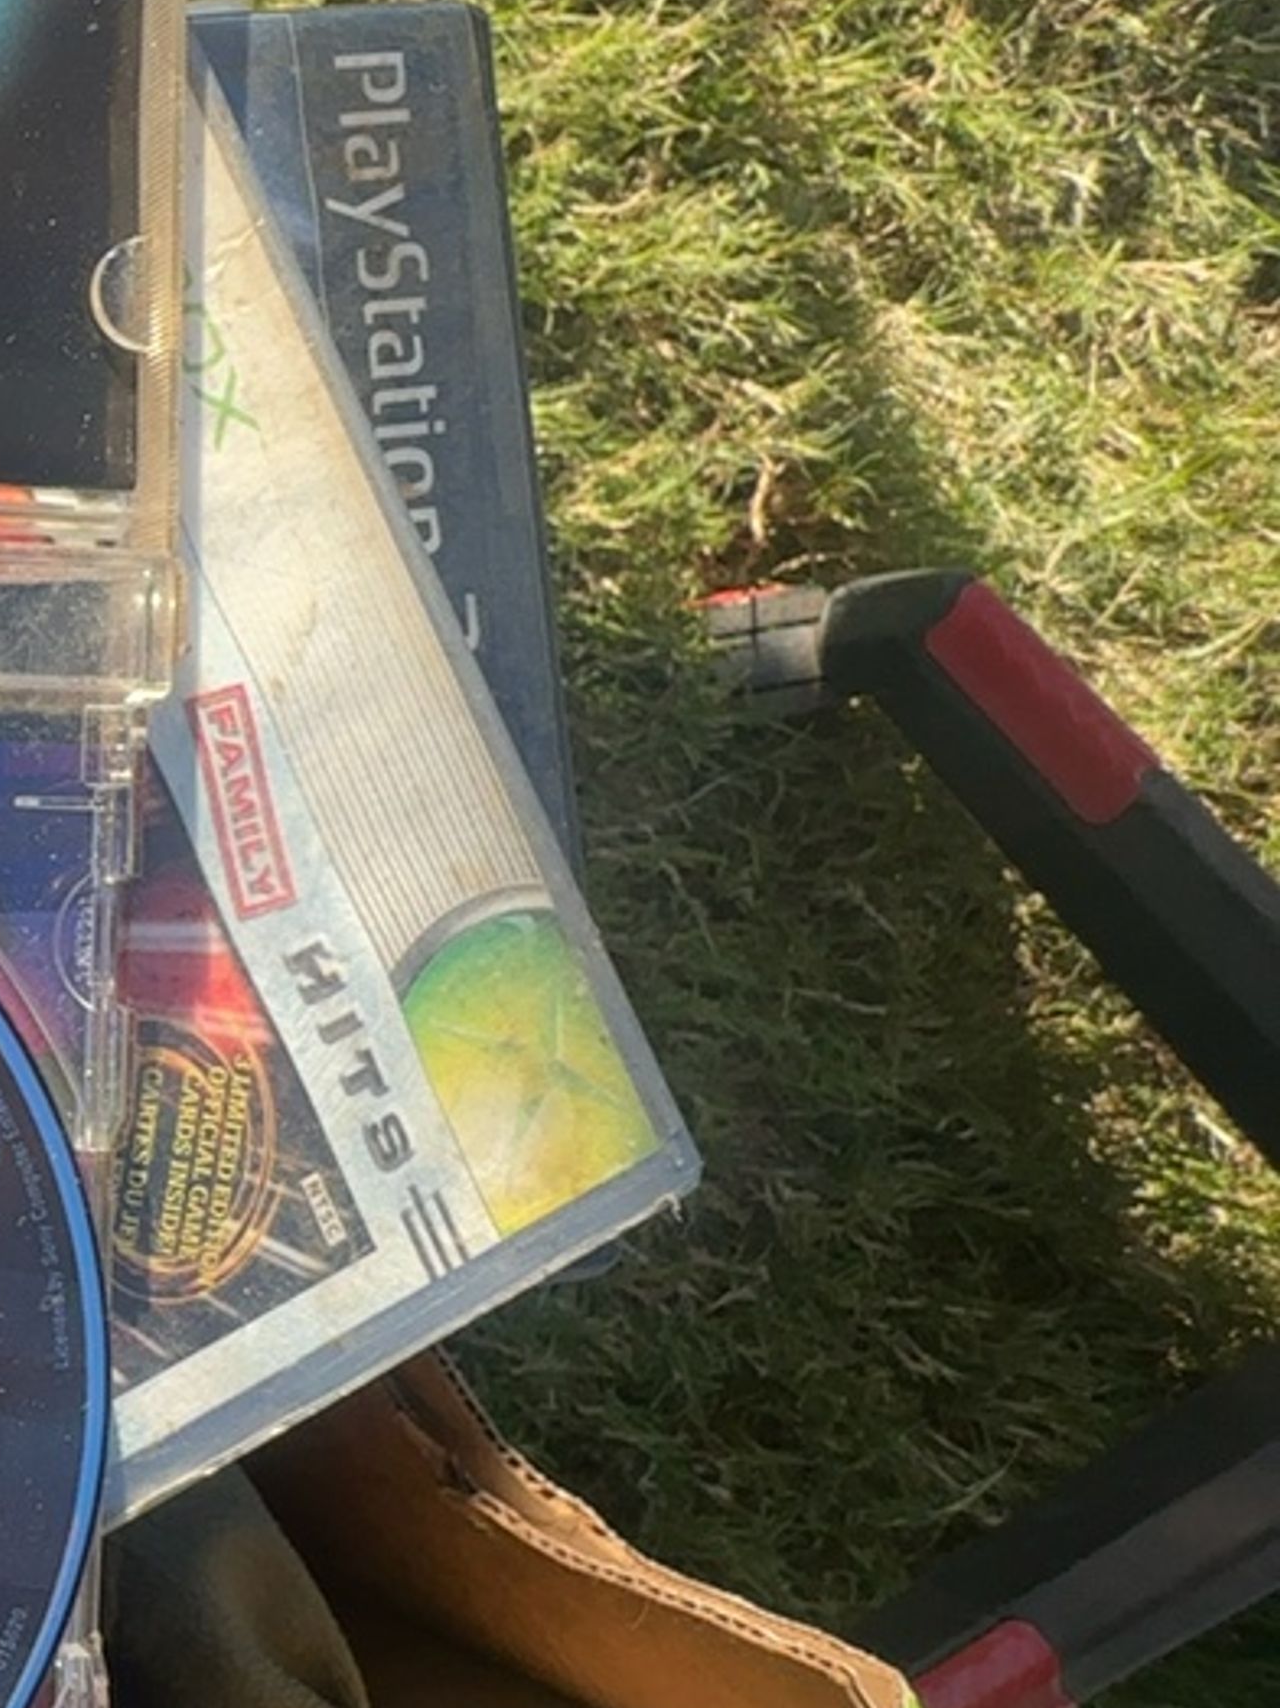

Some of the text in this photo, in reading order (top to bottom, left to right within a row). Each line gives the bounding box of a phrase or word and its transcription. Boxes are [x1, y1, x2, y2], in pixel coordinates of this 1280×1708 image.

[208, 703, 416, 1174] FAMILY HITS
[123, 1170, 146, 1207] DU
[131, 1068, 163, 1166] CARTES
[154, 1072, 203, 1255] CARDS INSIDE!
[193, 1066, 227, 1181] OFFICIAL
[197, 1054, 252, 1288] 3 LIMITED EDITION
